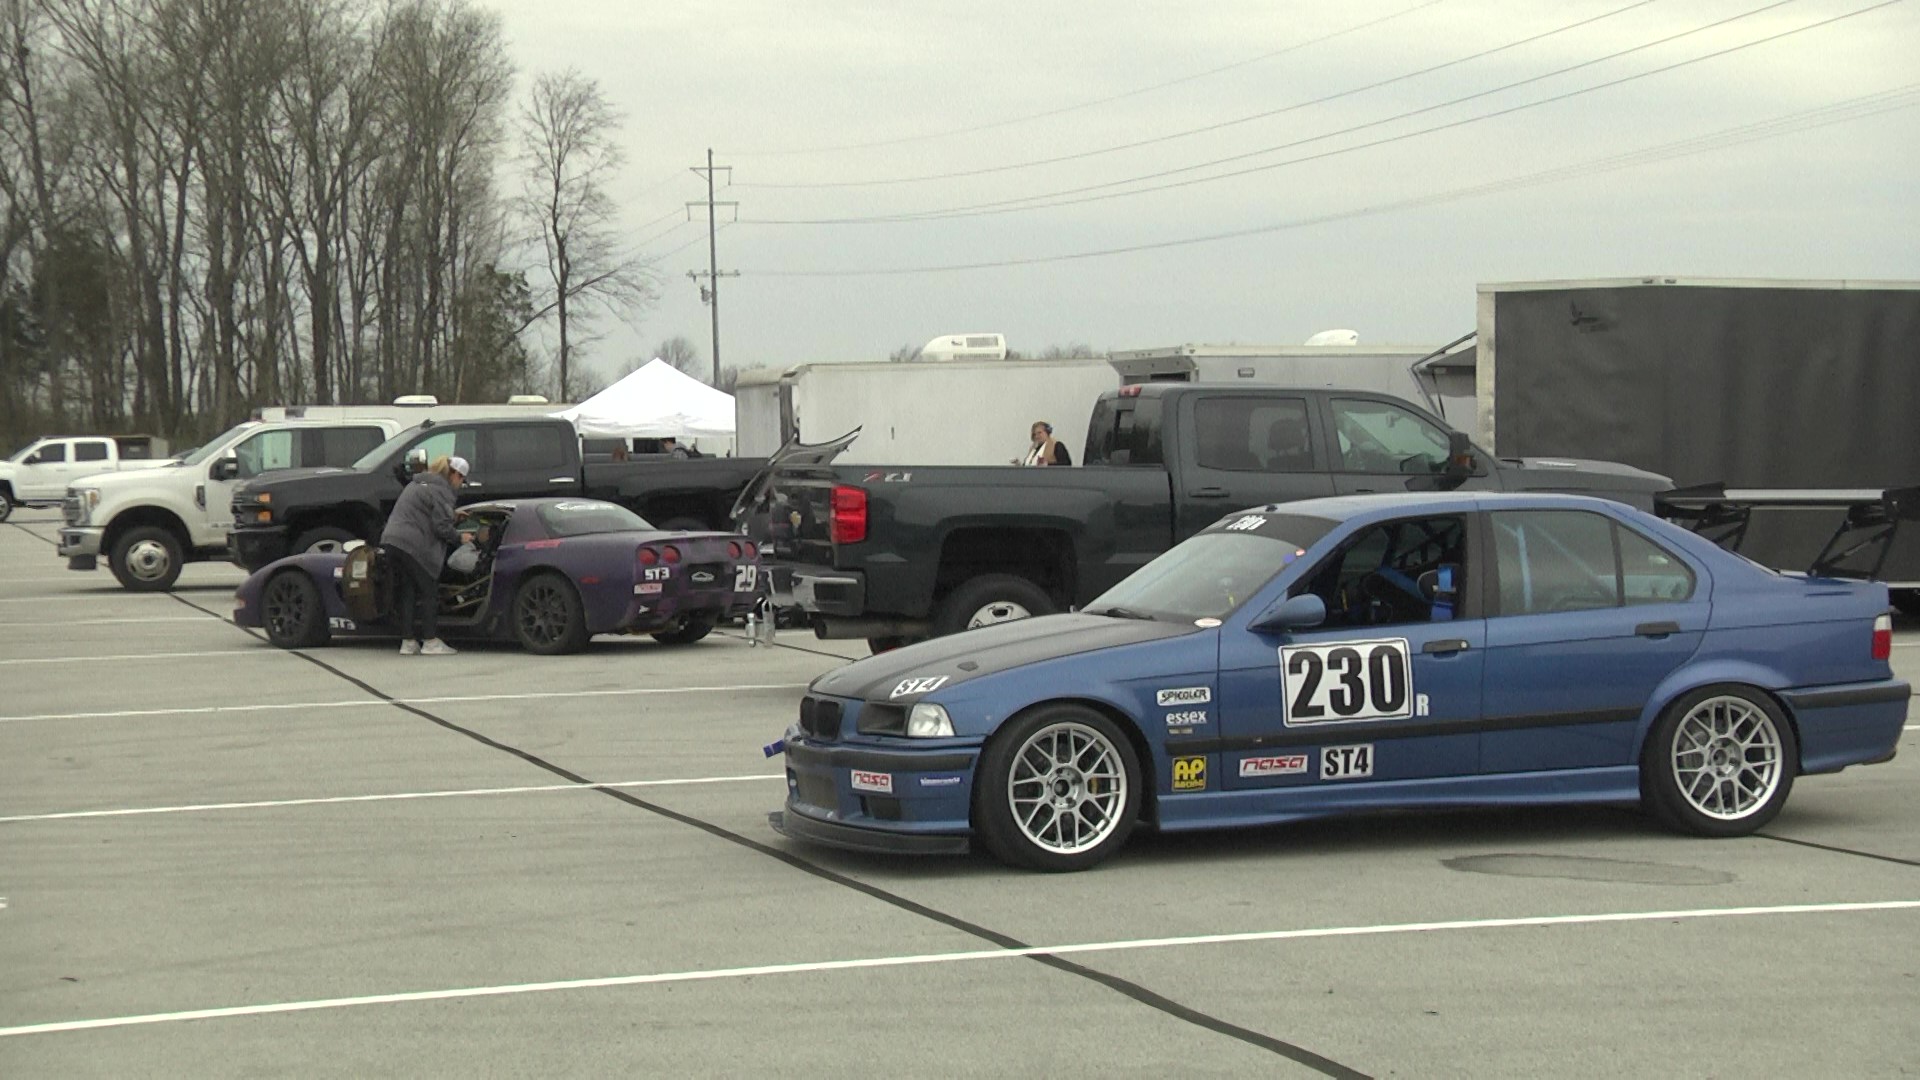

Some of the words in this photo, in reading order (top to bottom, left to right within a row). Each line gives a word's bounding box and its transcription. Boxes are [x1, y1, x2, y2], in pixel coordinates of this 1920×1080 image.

[645, 567, 670, 580] ST3
[734, 565, 757, 592] 29
[889, 675, 949, 699] ST4
[1289, 645, 1405, 718] 230
[1416, 693, 1429, 716] R
[1166, 711, 1207, 725] essex
[1174, 758, 1204, 780] AP
[1325, 747, 1369, 776] ST4
